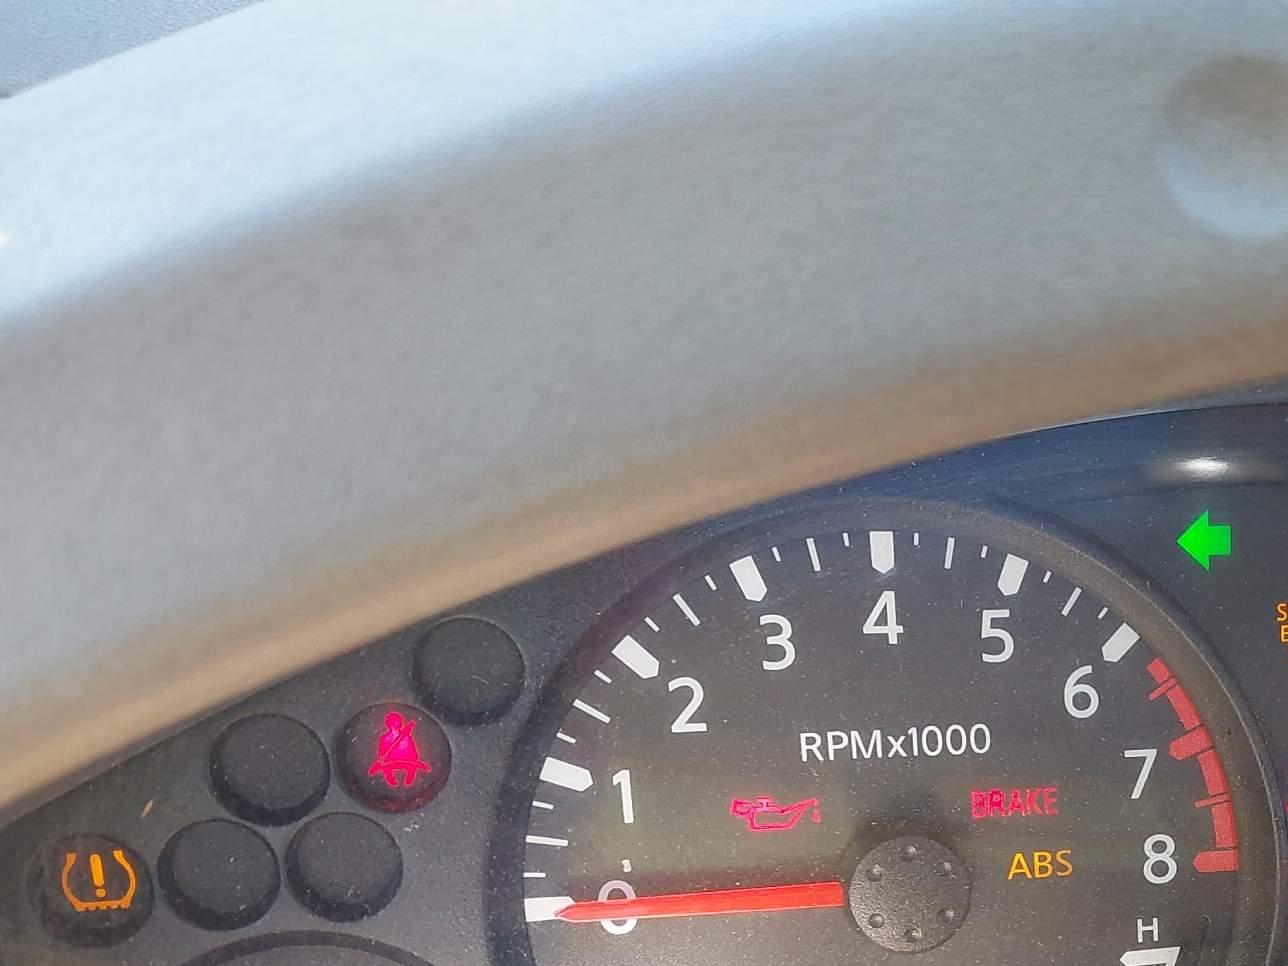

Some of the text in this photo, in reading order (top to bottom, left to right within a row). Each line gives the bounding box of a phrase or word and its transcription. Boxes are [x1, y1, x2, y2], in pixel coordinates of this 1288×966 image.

[760, 615, 795, 670] 3
[863, 591, 903, 644] 4
[982, 610, 1013, 662] 5
[669, 677, 707, 732] 2
[1065, 666, 1098, 718] 6
[800, 724, 990, 761] RPMx1000
[613, 770, 633, 823] 1
[1125, 749, 1157, 799] 7
[970, 787, 1058, 818] BRAKE
[1008, 851, 1072, 879] ABS
[1144, 835, 1176, 883] 8
[1138, 918, 1158, 942] H
